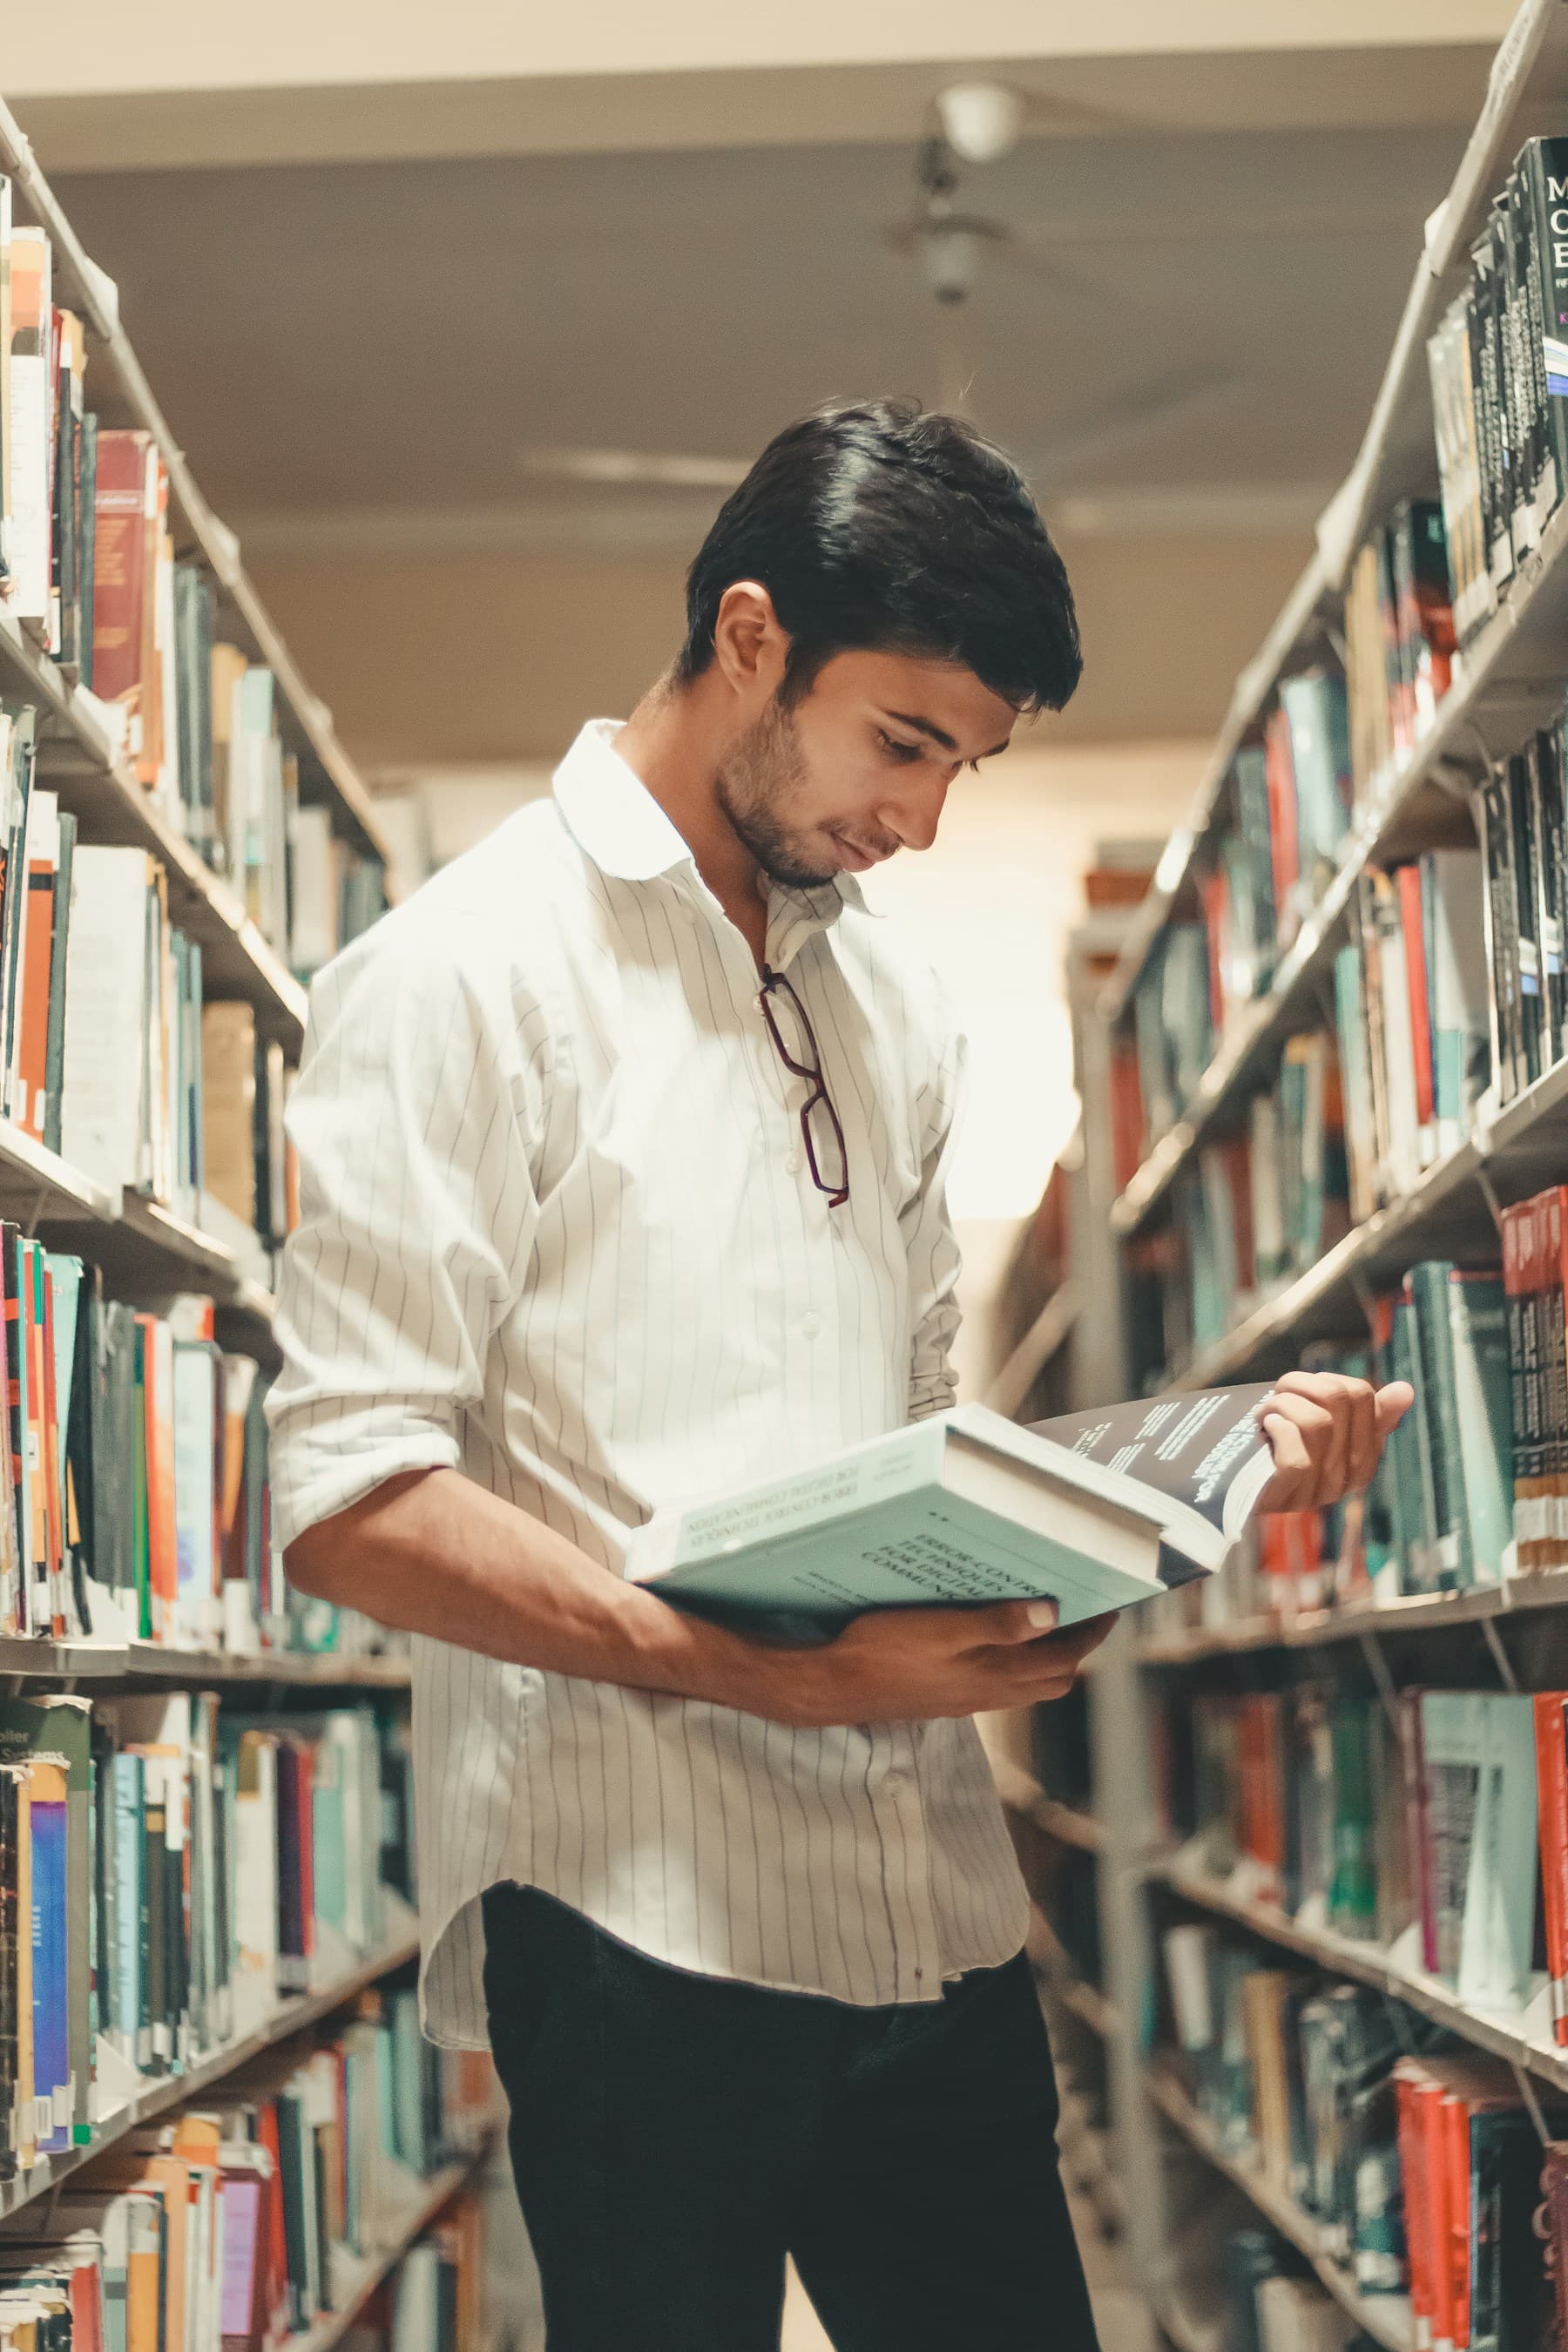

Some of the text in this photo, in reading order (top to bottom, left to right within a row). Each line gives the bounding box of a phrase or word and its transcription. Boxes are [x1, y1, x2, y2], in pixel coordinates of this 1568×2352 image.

[878, 1545, 984, 1598] FOR DIGITAL
[899, 1540, 1004, 1592] TECHNIQUES
[916, 1534, 1056, 1597] ERROR-CONTRO
